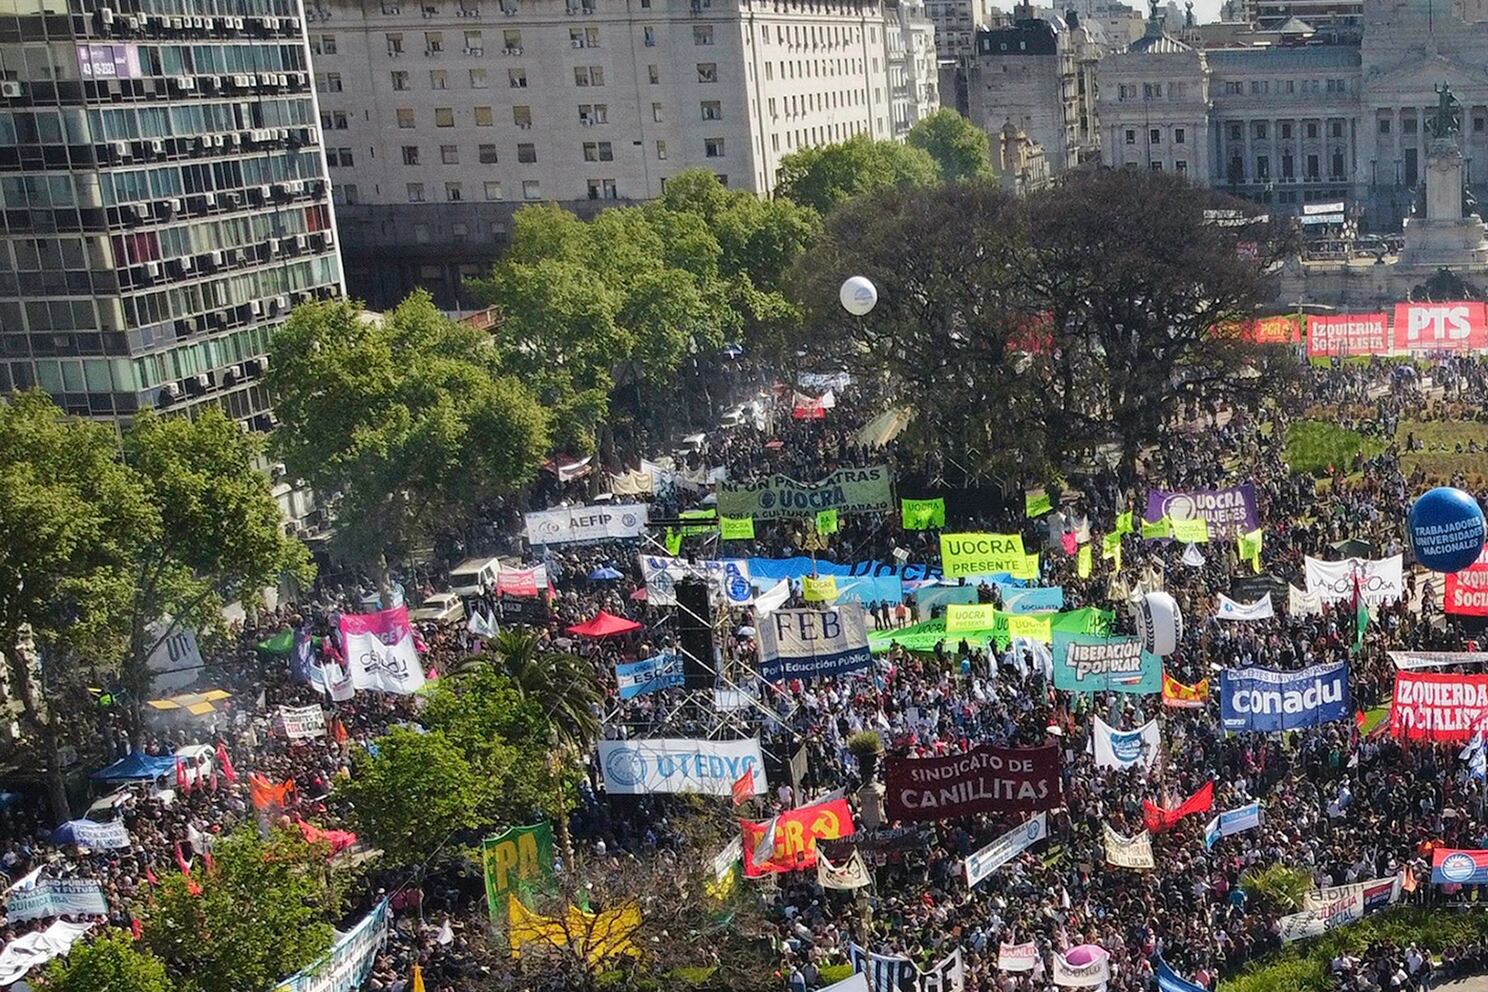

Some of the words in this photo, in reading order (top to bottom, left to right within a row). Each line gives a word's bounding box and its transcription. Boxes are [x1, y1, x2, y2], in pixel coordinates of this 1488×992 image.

[1311, 320, 1383, 338] IZQUIERDA
[1407, 307, 1470, 340] PTS
[1311, 337, 1384, 352] SOCIALISTA
[722, 482, 738, 493] NI
[826, 468, 881, 487] ATRAS
[779, 485, 847, 509] UOCRA
[1196, 491, 1246, 510] UOCRA
[568, 514, 612, 528] AEFIP
[1414, 516, 1482, 537] TRABAJADORES
[947, 538, 1017, 557] UOCRA
[1414, 526, 1484, 548] UNIVERSIDADES
[1422, 539, 1479, 557] NACIONALES
[952, 559, 1020, 574] PRESENTE
[953, 609, 986, 619] UOCRA
[775, 611, 841, 642] FEB
[1066, 641, 1142, 667] LIBERACIÓN
[785, 658, 837, 674] Educación
[1232, 678, 1343, 715] conadu
[1398, 683, 1488, 708] IZQUIERDA
[656, 754, 761, 780] UTEDYC
[910, 757, 1003, 784] SINDICATO
[1007, 758, 1034, 773] DE
[901, 778, 1048, 809] CANILLITAS
